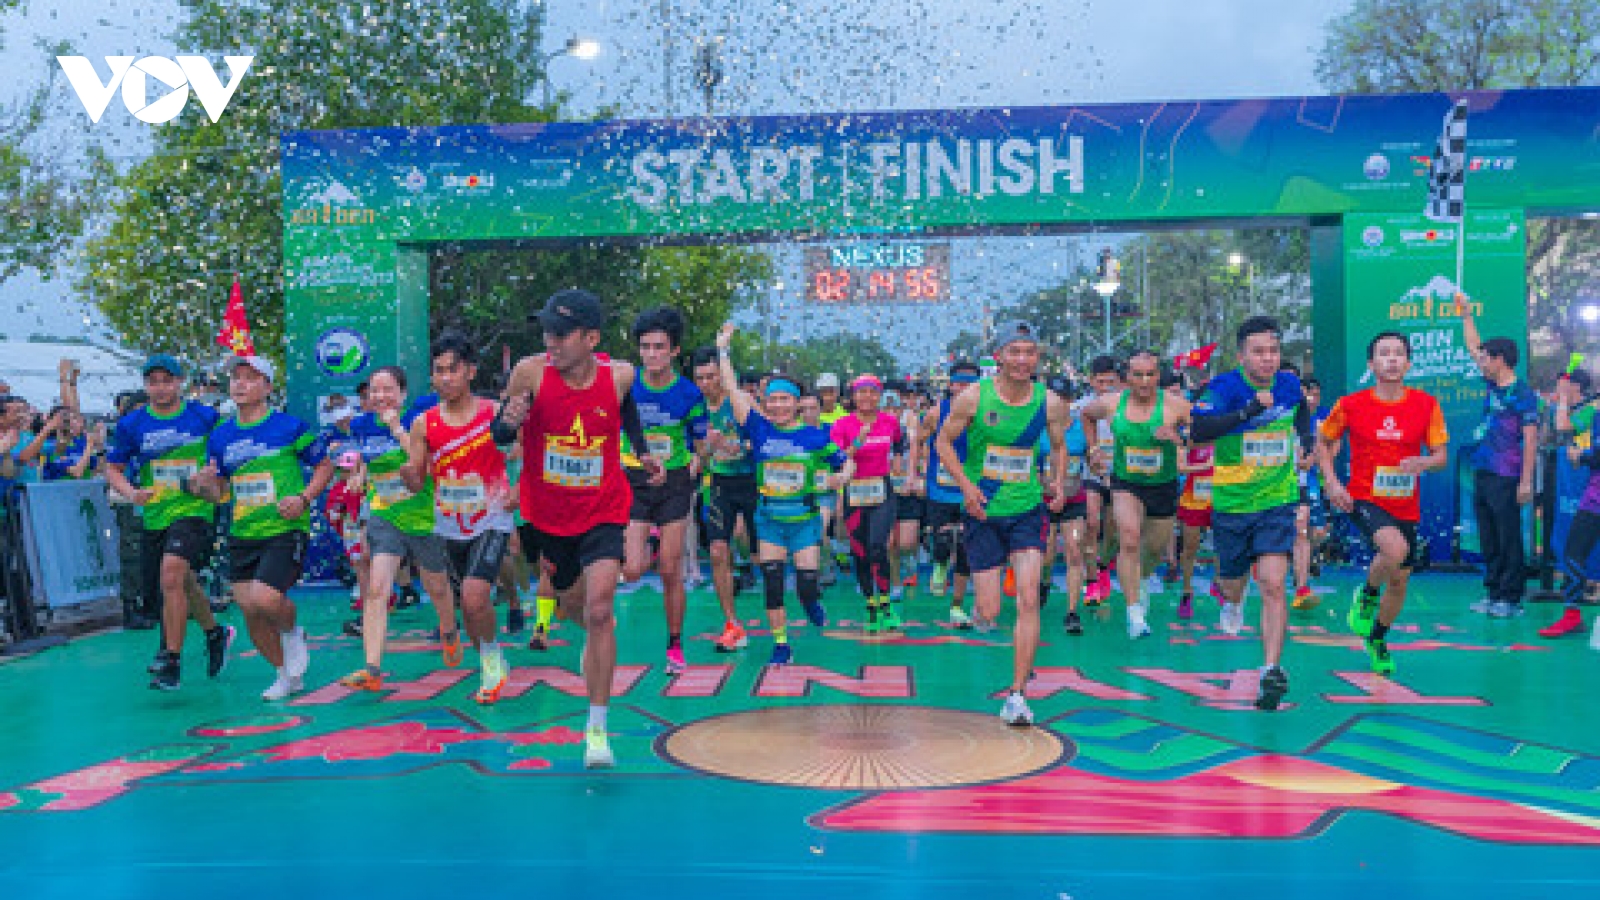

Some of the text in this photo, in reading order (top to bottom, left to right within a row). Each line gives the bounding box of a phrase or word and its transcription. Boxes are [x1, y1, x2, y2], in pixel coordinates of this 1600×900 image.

[629, 136, 1084, 206] START FINISH
[832, 245, 925, 267] NEXUS
